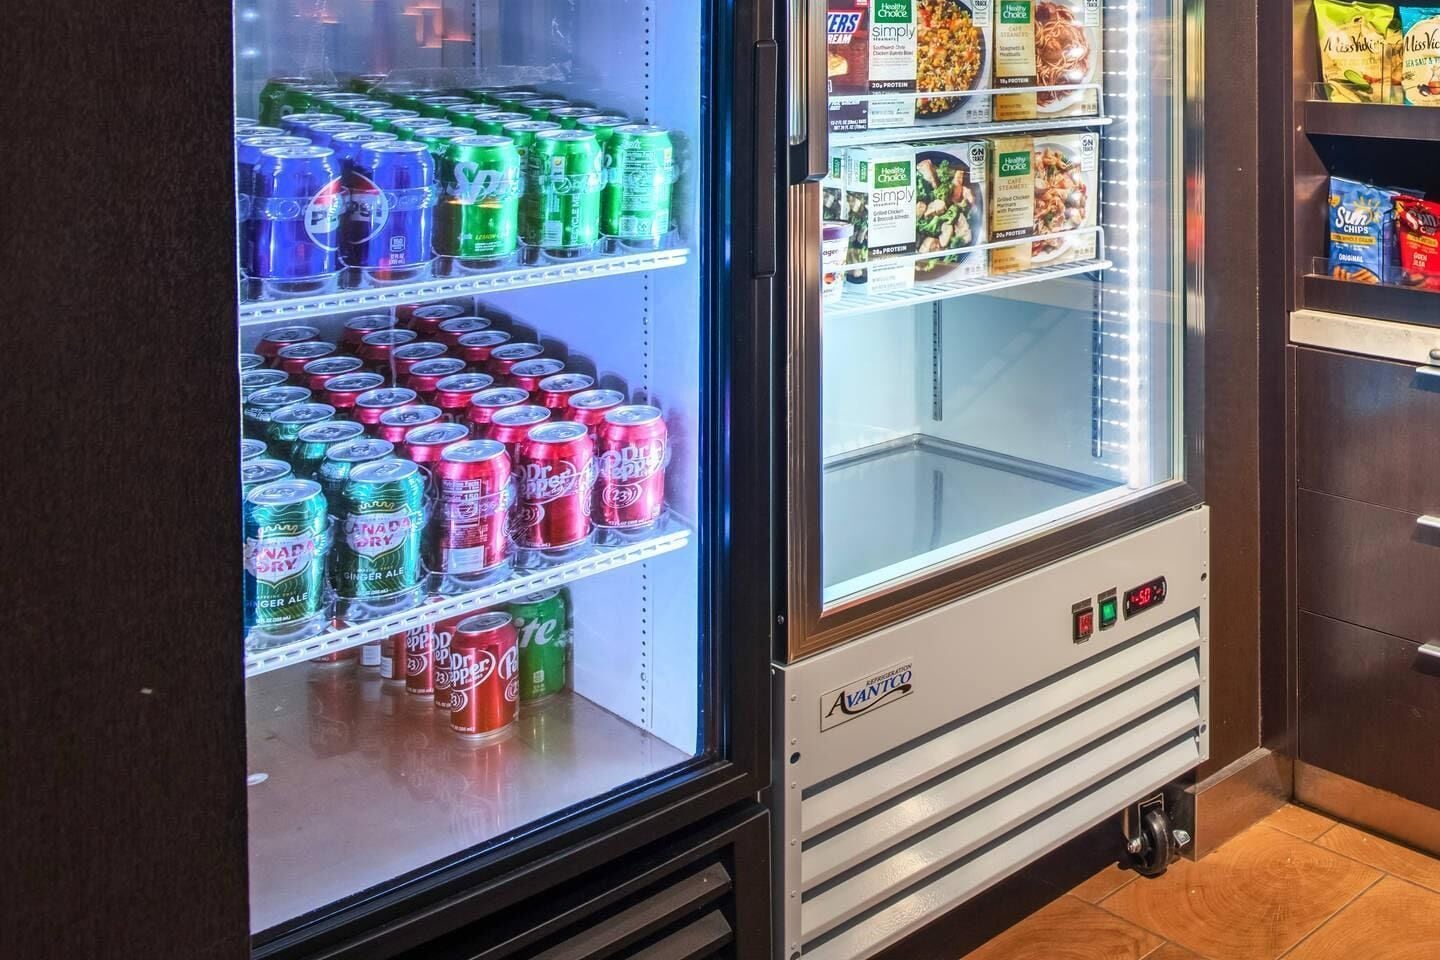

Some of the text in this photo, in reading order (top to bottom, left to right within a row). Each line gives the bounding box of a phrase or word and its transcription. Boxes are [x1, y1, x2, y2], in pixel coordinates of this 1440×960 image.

[878, 8, 908, 18] Choice
[881, 2, 907, 12] Healthy
[1006, 4, 1026, 13] Healthy
[1003, 11, 1027, 19] Choice
[872, 25, 915, 42] simply
[1404, 35, 1426, 52] Miss
[1005, 156, 1026, 165] Healthy
[881, 167, 906, 176] Healthy
[1002, 162, 1027, 172] Choice
[878, 173, 907, 183] Choice
[872, 187, 914, 205] simply
[1335, 206, 1369, 228] Sun
[1343, 224, 1368, 233] CHIPS
[882, 245, 907, 254] PROTEIN
[1339, 253, 1363, 263] ORIGINAL
[527, 463, 552, 479] Dr
[612, 490, 628, 502] 23
[356, 534, 393, 548] DRY
[256, 559, 297, 573] DRY
[344, 567, 405, 580] GINGER ALE
[287, 592, 308, 605] ALE
[451, 653, 472, 668] Dr
[866, 663, 912, 686] REFRIGERATION
[825, 670, 912, 718] AVANTCO
